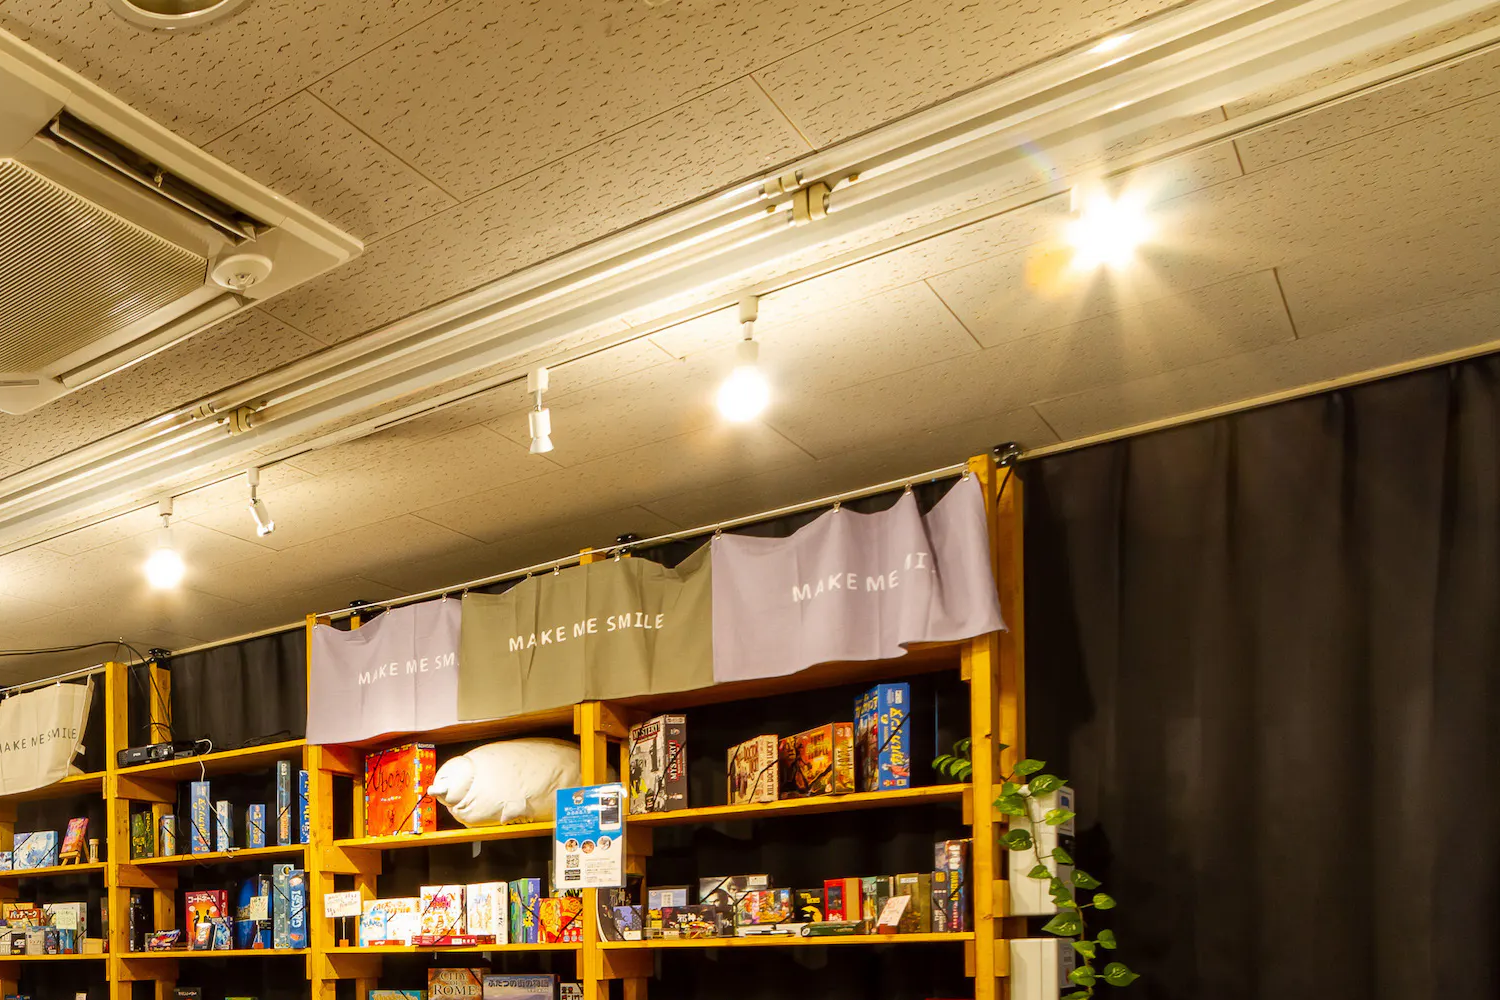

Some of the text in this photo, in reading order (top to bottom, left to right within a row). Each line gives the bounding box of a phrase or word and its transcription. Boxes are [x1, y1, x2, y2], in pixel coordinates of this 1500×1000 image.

[792, 570, 899, 602] MAKE ME
[509, 612, 665, 652] MAKE ME SMILE
[358, 662, 398, 685] MAKE
[406, 658, 429, 674] ME
[31, 733, 45, 748] ME
[47, 728, 77, 742] SMILE
[433, 985, 477, 996] ROME
